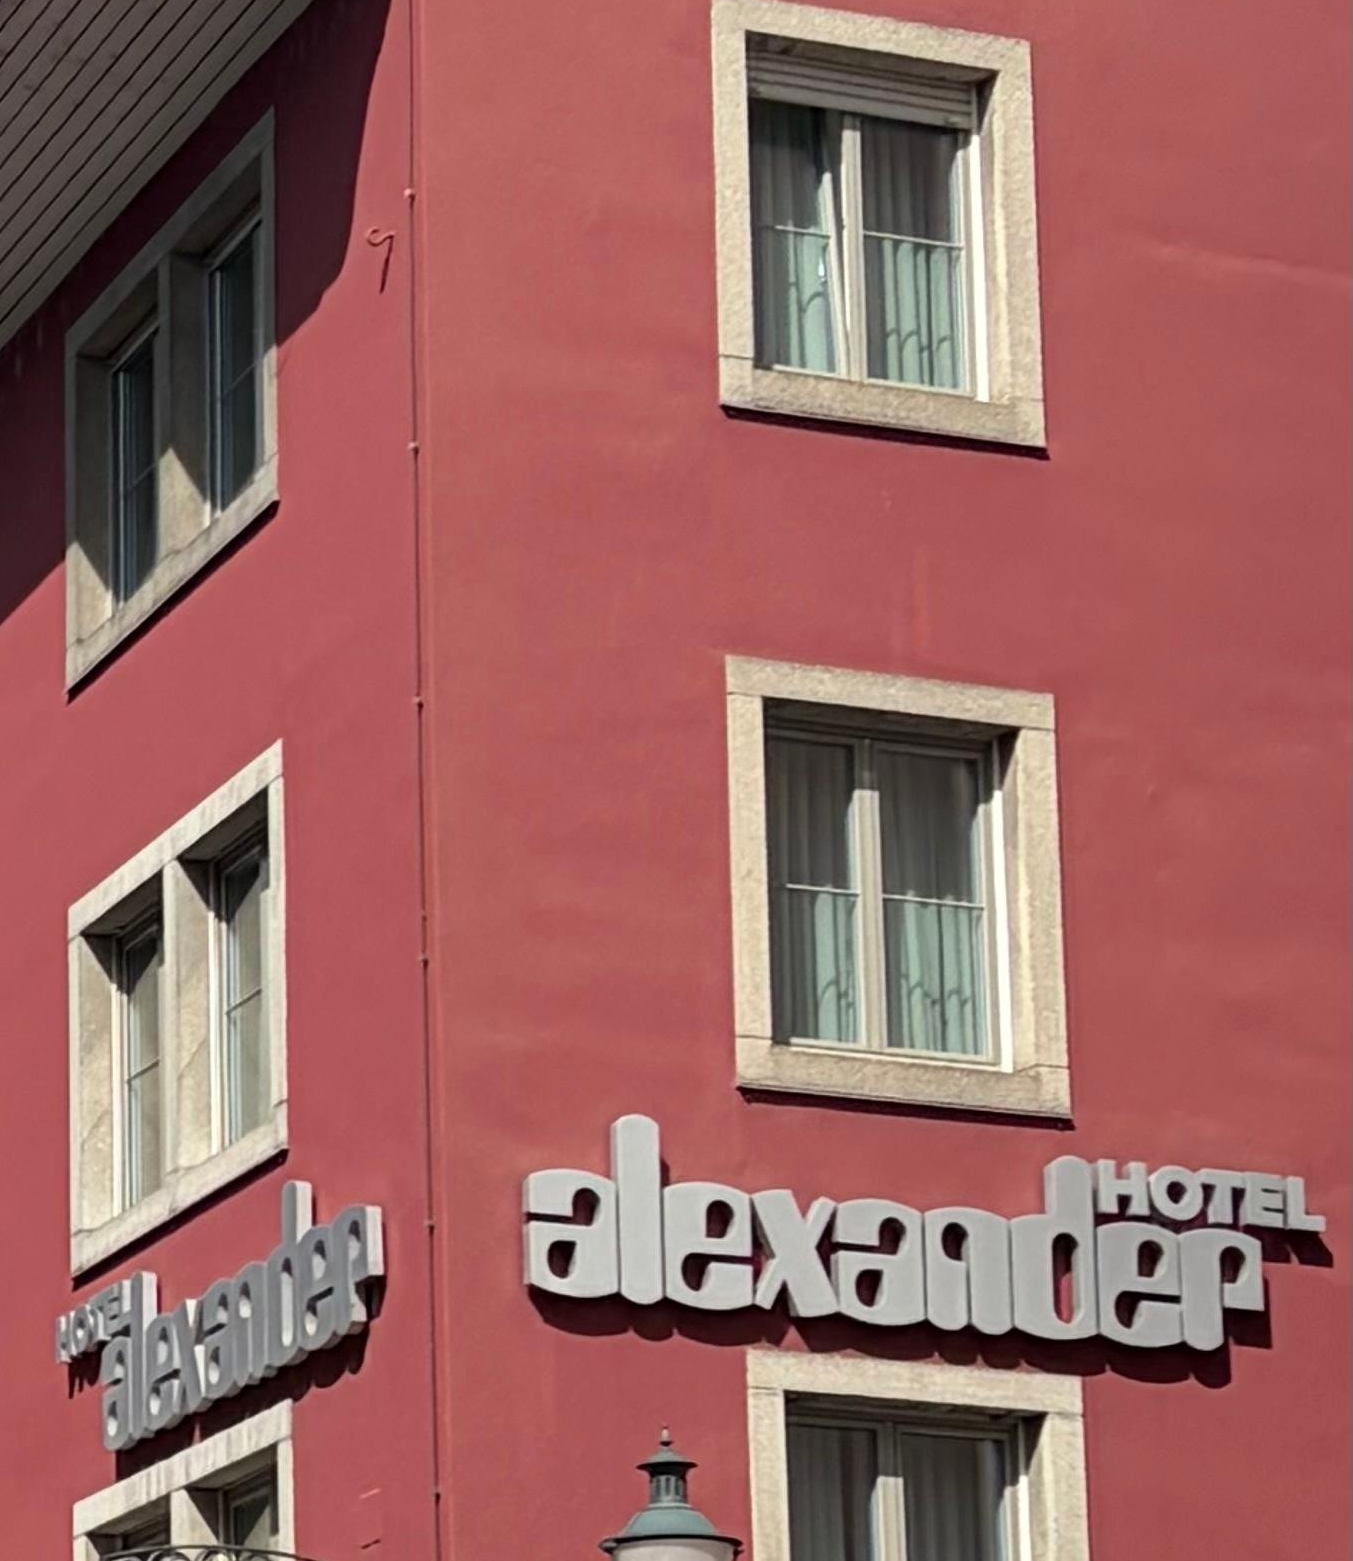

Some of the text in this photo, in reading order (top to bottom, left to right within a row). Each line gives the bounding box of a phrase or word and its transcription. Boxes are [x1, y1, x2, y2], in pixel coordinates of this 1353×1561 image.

[522, 1114, 1264, 1351] alexander
[1096, 1157, 1326, 1232] HOTEL
[101, 1180, 384, 1452] alexander
